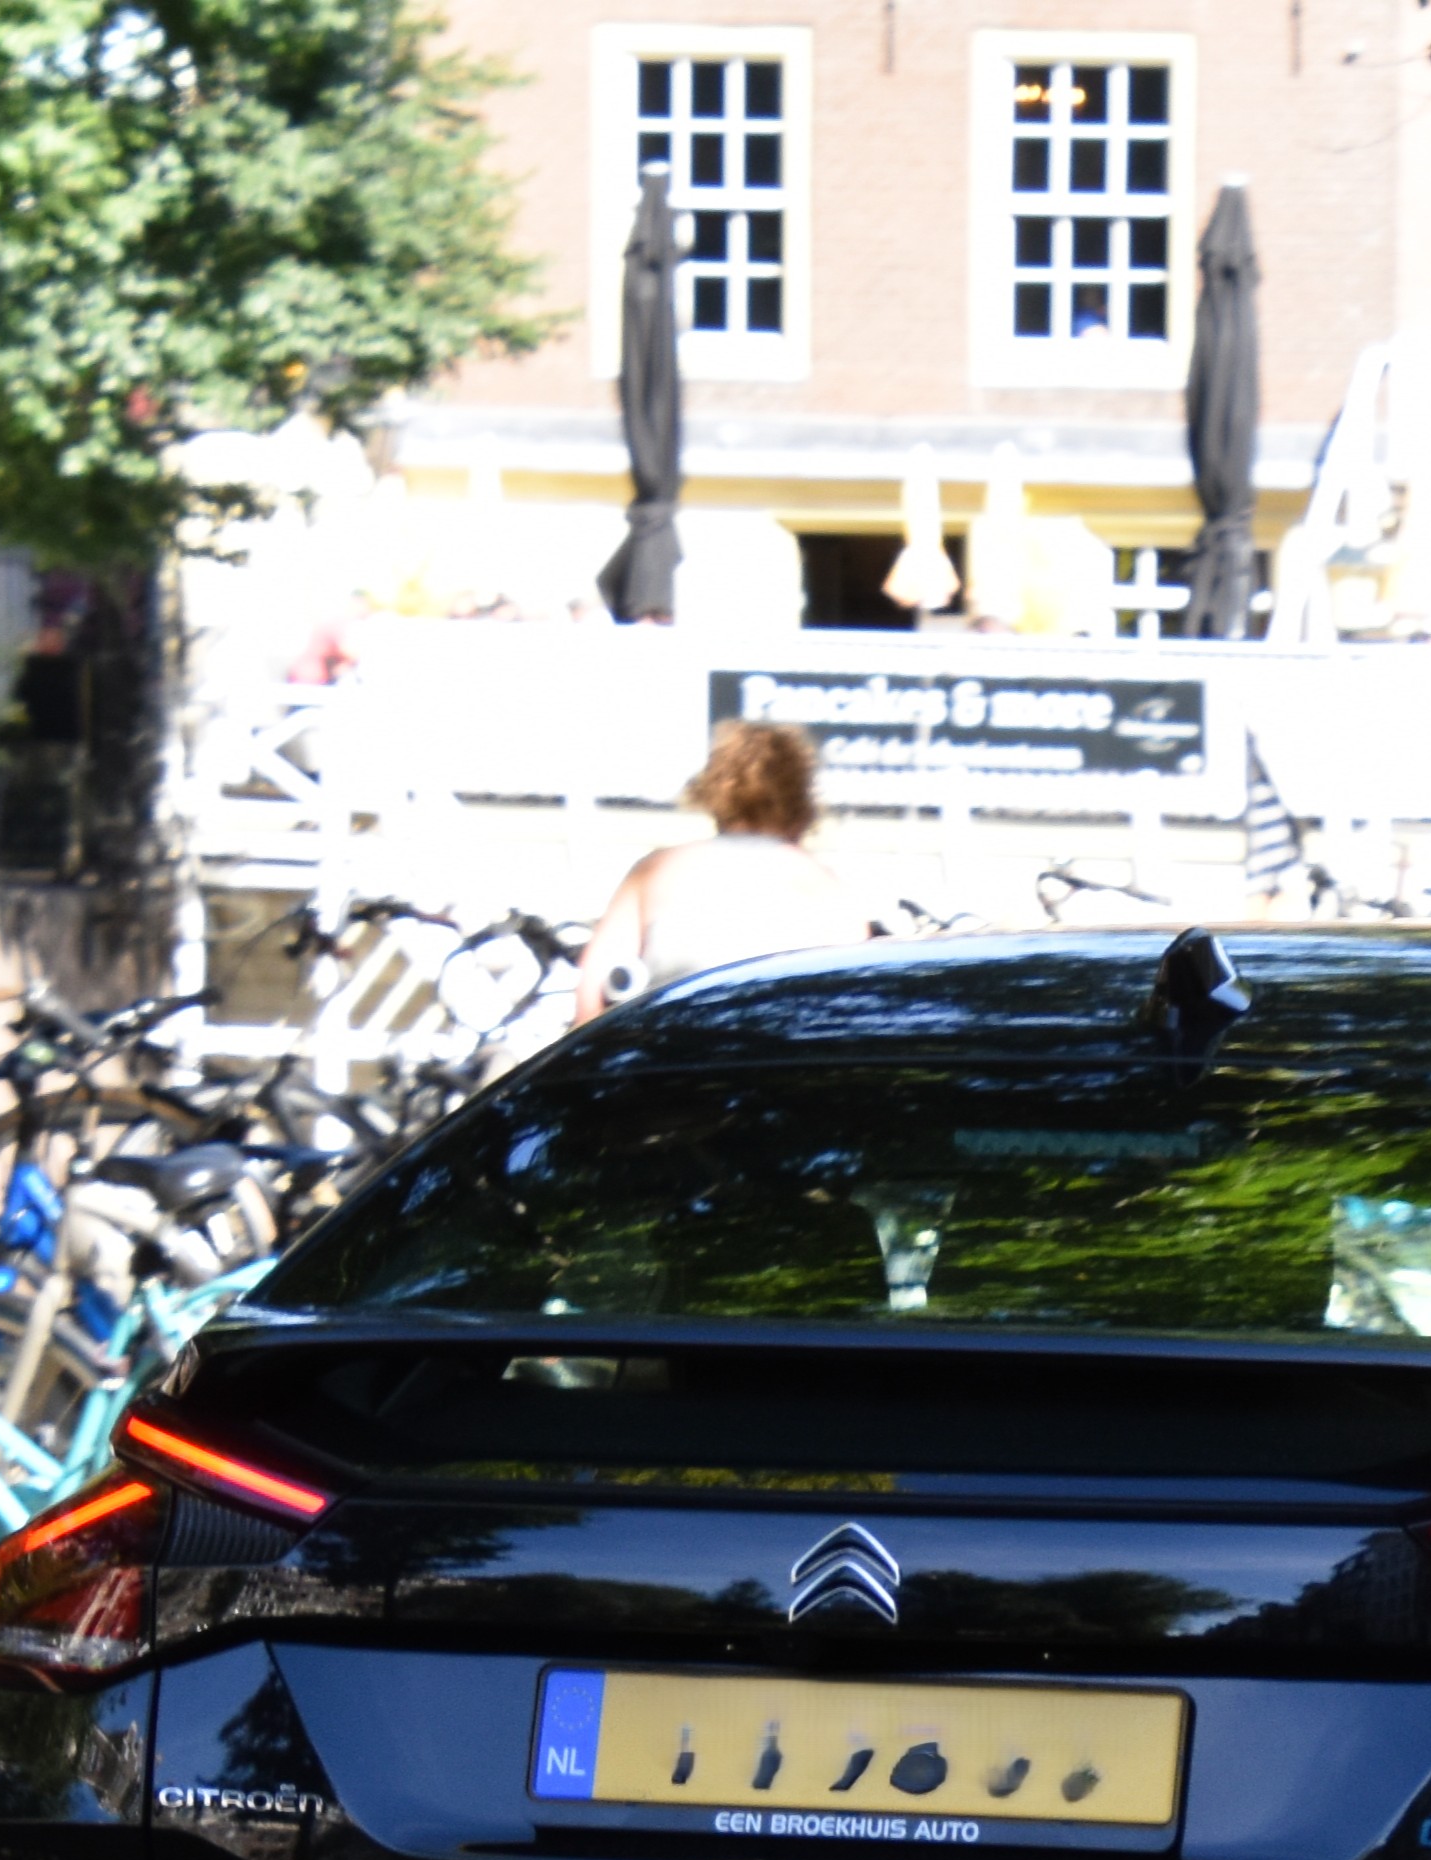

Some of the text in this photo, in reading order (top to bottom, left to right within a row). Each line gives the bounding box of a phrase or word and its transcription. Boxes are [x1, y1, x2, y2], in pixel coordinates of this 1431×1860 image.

[547, 1746, 586, 1775] NL
[715, 1811, 980, 1842] EEN BROEKHUIS AUTO
